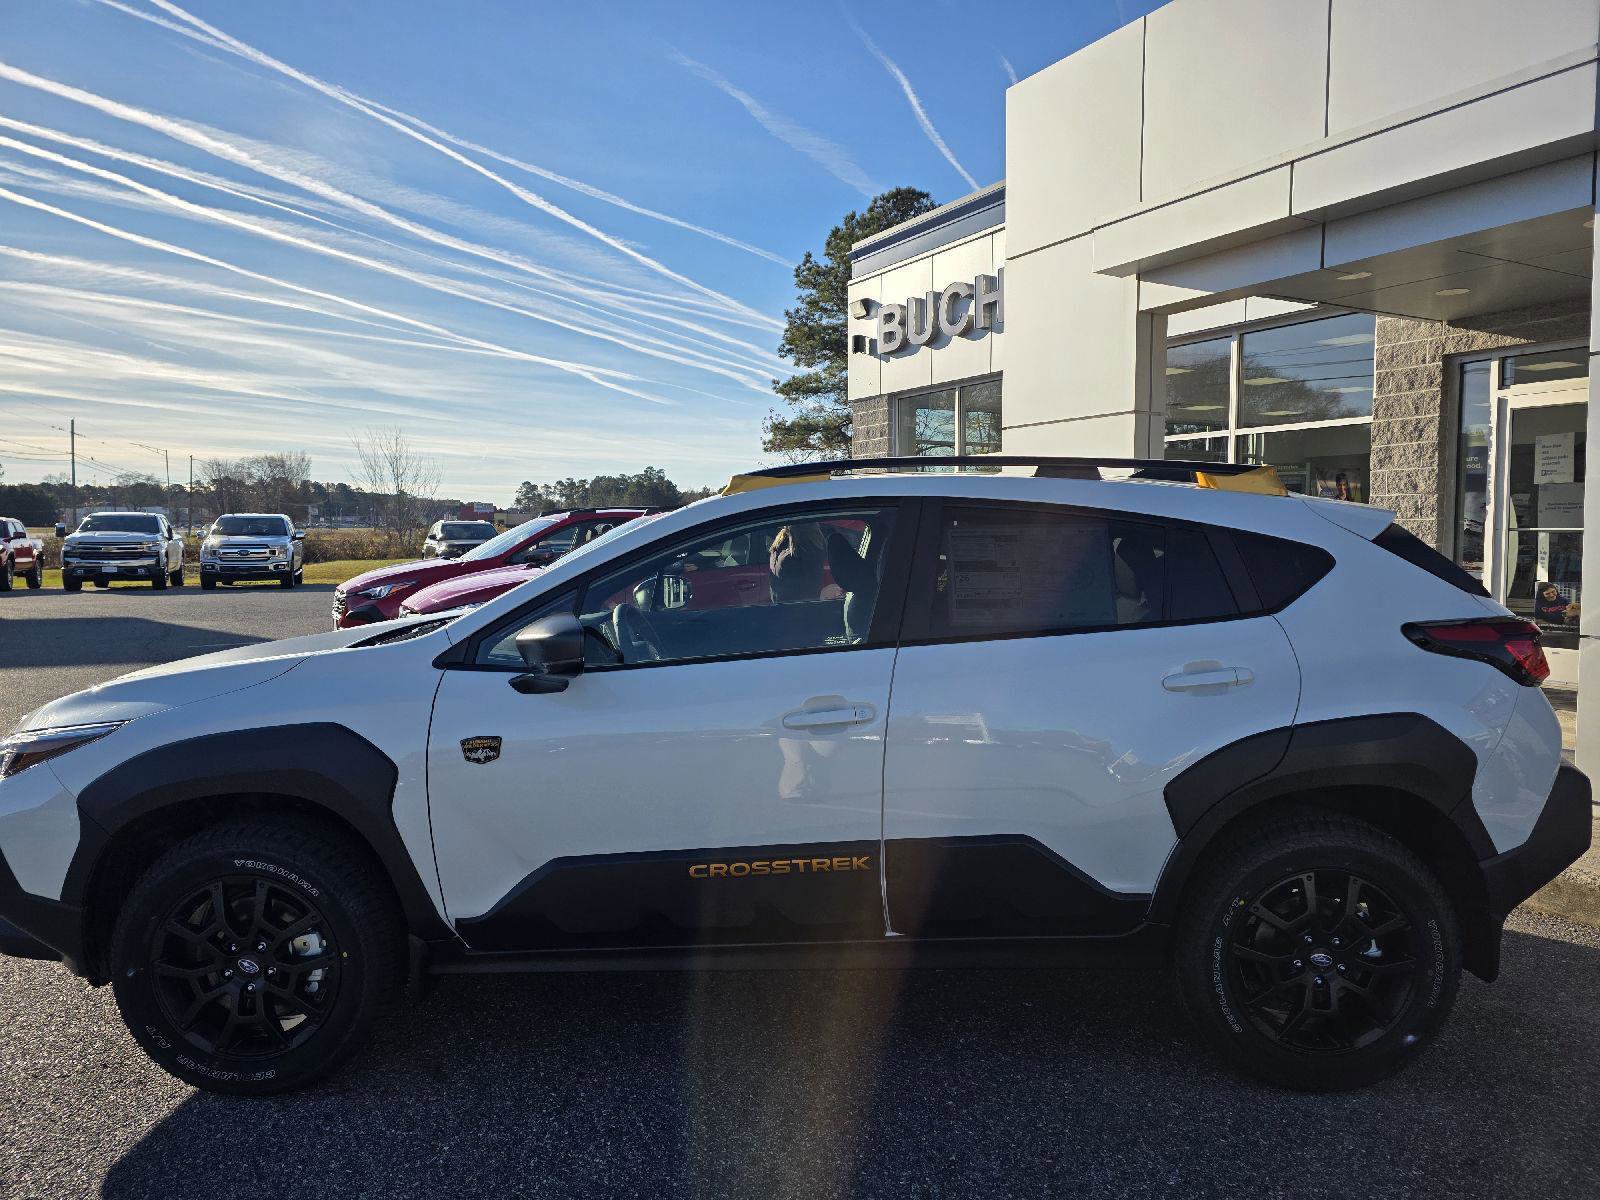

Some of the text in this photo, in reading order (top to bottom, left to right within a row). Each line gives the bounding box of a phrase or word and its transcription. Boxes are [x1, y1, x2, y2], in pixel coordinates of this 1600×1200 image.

[877, 267, 1005, 355] BUCH
[234, 859, 319, 897] YOKOHAMA
[688, 856, 872, 878] CROSSTREK
